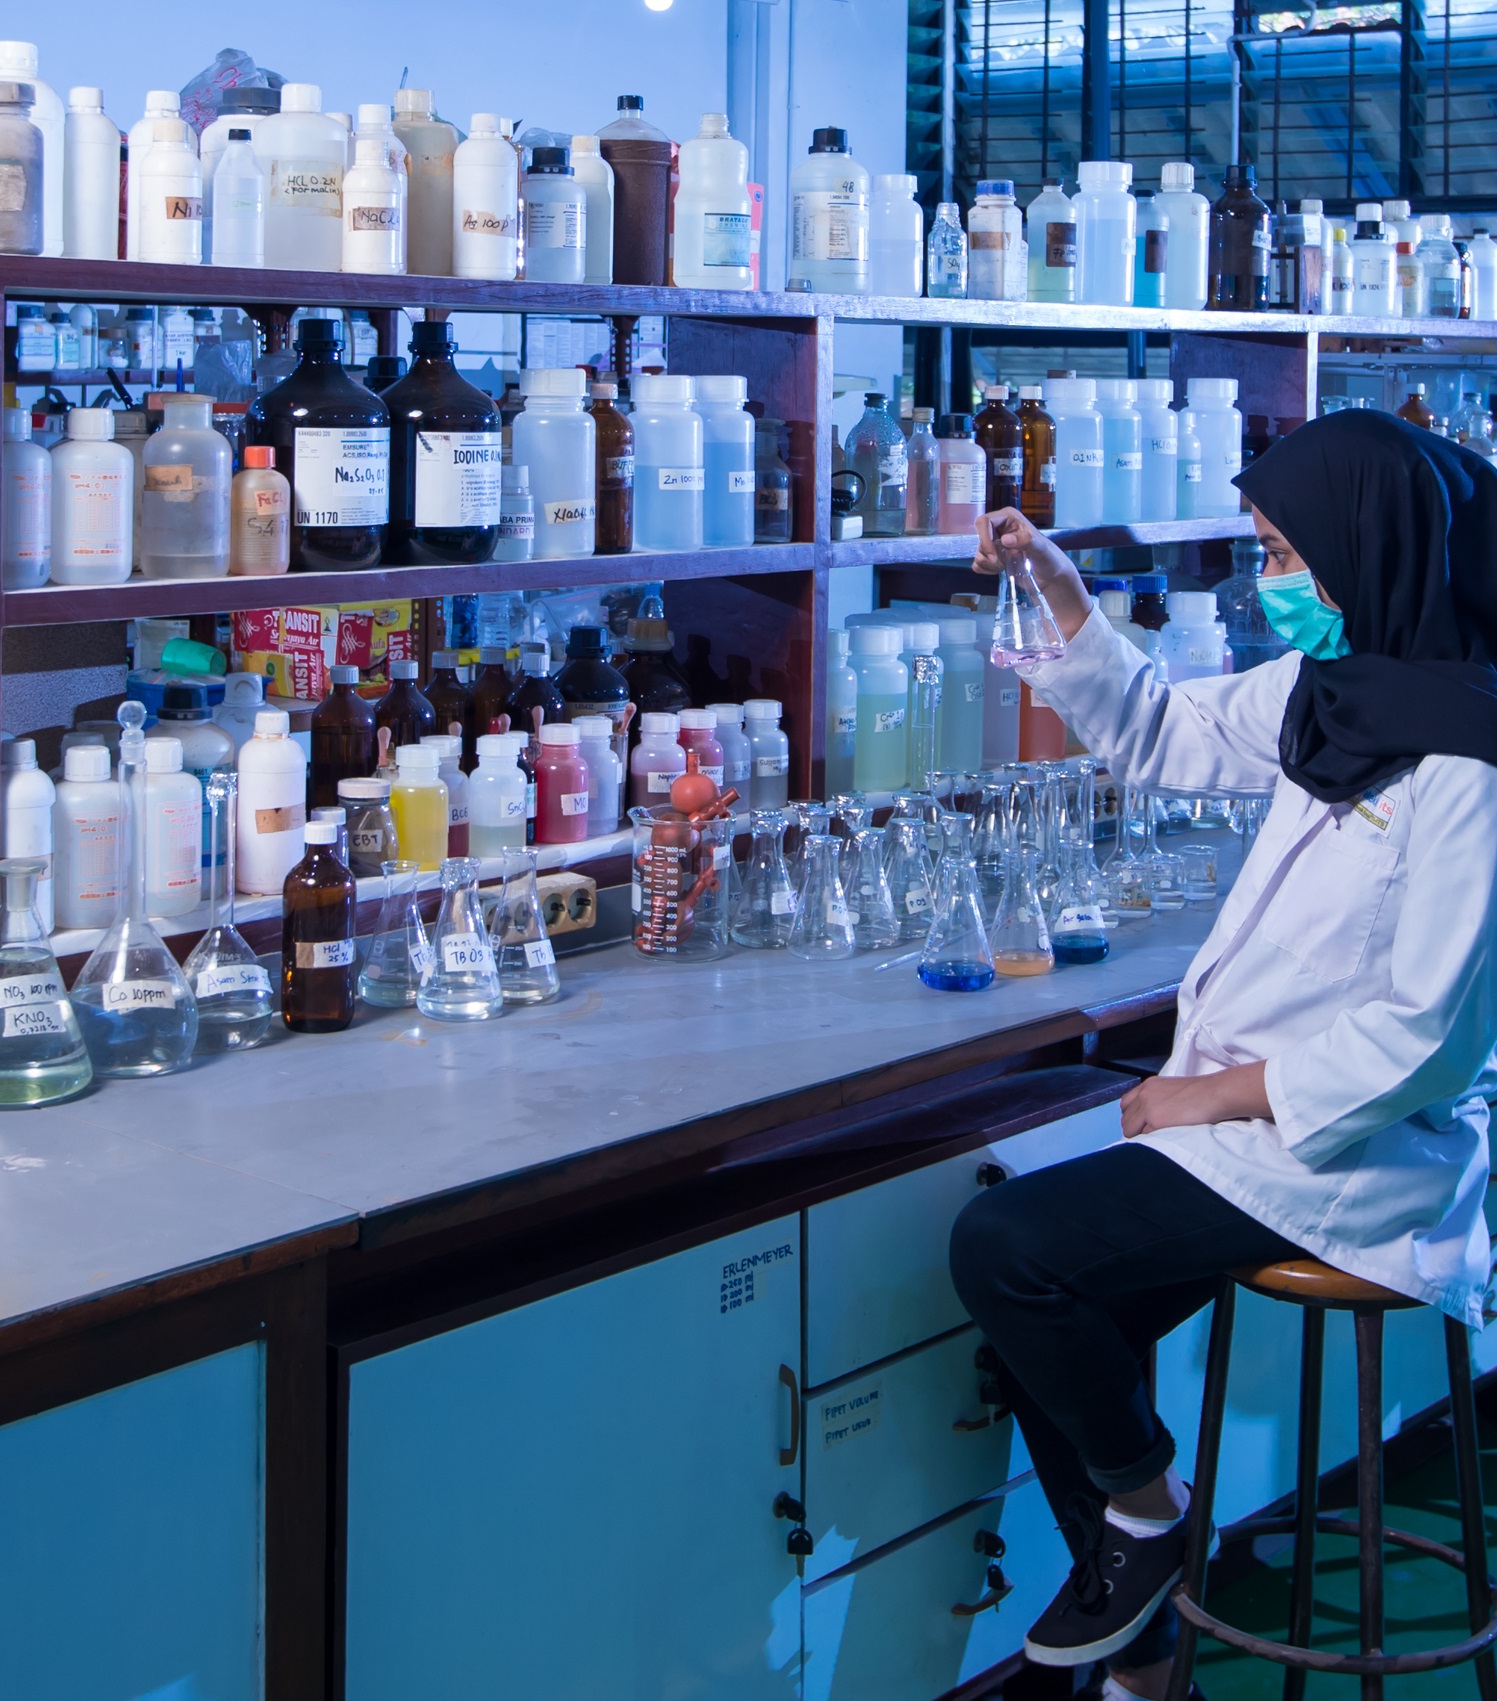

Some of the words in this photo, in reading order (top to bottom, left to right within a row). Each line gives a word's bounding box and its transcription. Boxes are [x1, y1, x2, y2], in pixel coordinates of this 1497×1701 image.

[842, 181, 854, 193] 48
[453, 449, 489, 465] IODINE
[297, 511, 310, 525] UN
[315, 511, 339, 525] 1170
[272, 610, 320, 634] TANSIT
[352, 833, 379, 847] EBT
[723, 1244, 794, 1280] ERLENMEYER
[729, 1288, 743, 1301] 200
[729, 1298, 743, 1311] 100
